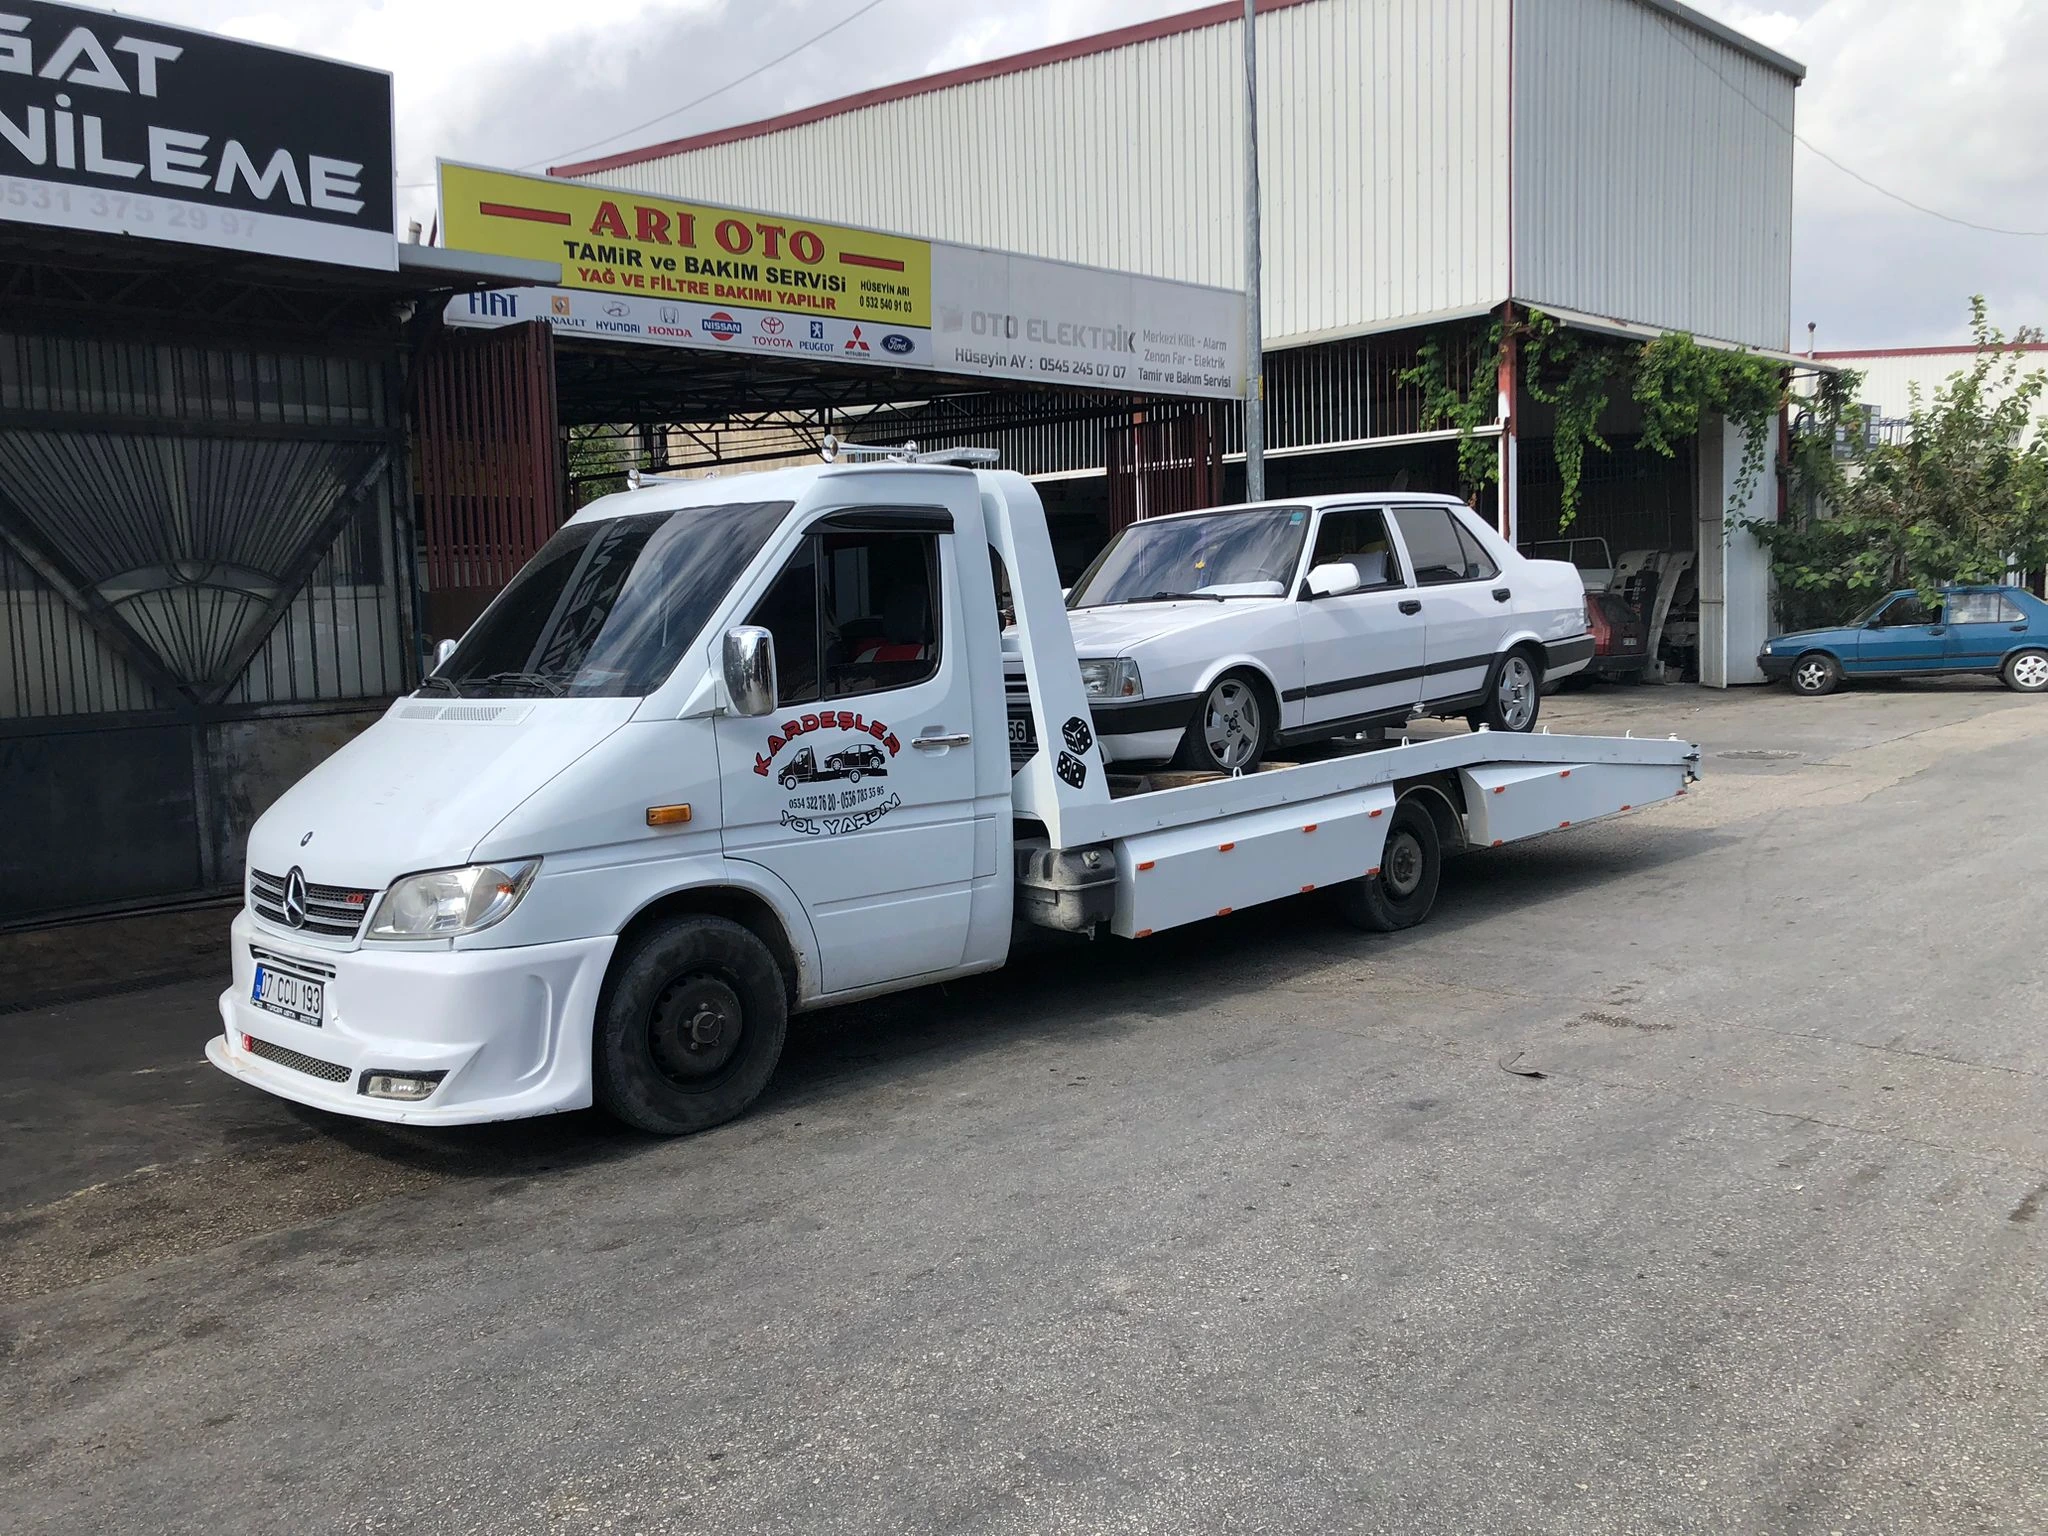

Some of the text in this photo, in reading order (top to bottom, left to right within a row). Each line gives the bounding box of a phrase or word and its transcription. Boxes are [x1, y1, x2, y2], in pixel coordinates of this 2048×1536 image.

[0, 181, 260, 238] 531 375 29 97
[589, 200, 825, 266] ARI OTO
[649, 255, 677, 272] ve
[684, 256, 759, 282] BAKIM
[577, 267, 837, 311] YAĞ VE FİLTRE BAKIMI YAPILIR
[896, 286, 910, 297] ARI
[468, 291, 519, 318] FIAT
[859, 295, 912, 313] 0 532 540 91 03
[535, 314, 588, 328] RENAULT
[595, 321, 641, 334] HYUNDAI
[647, 325, 693, 338] HONDA
[702, 321, 741, 333] NISSAN
[970, 310, 1137, 354] OTO ELEKTRİK
[752, 335, 794, 349] TOYOTA
[799, 340, 835, 353] PEUGEOT
[887, 336, 909, 351] Ford
[1142, 328, 1177, 346] Merkezi
[1202, 336, 1227, 352] Alarm
[955, 347, 1007, 368] Hüseyin
[1010, 354, 1027, 369] AY
[1039, 357, 1070, 374] 0545
[1072, 360, 1093, 376] 245
[1096, 363, 1111, 378] 07
[1112, 364, 1127, 379] 07
[1143, 348, 1171, 364] Zenon
[1172, 351, 1186, 365] Far
[1194, 354, 1226, 369] Elektrik
[1137, 367, 1232, 389] Tamir ve Bakım Servisi
[753, 710, 901, 777] KARDEŞLER
[780, 792, 901, 835] YOL YARDIM
[260, 971, 320, 1015] 07 CCU 193
